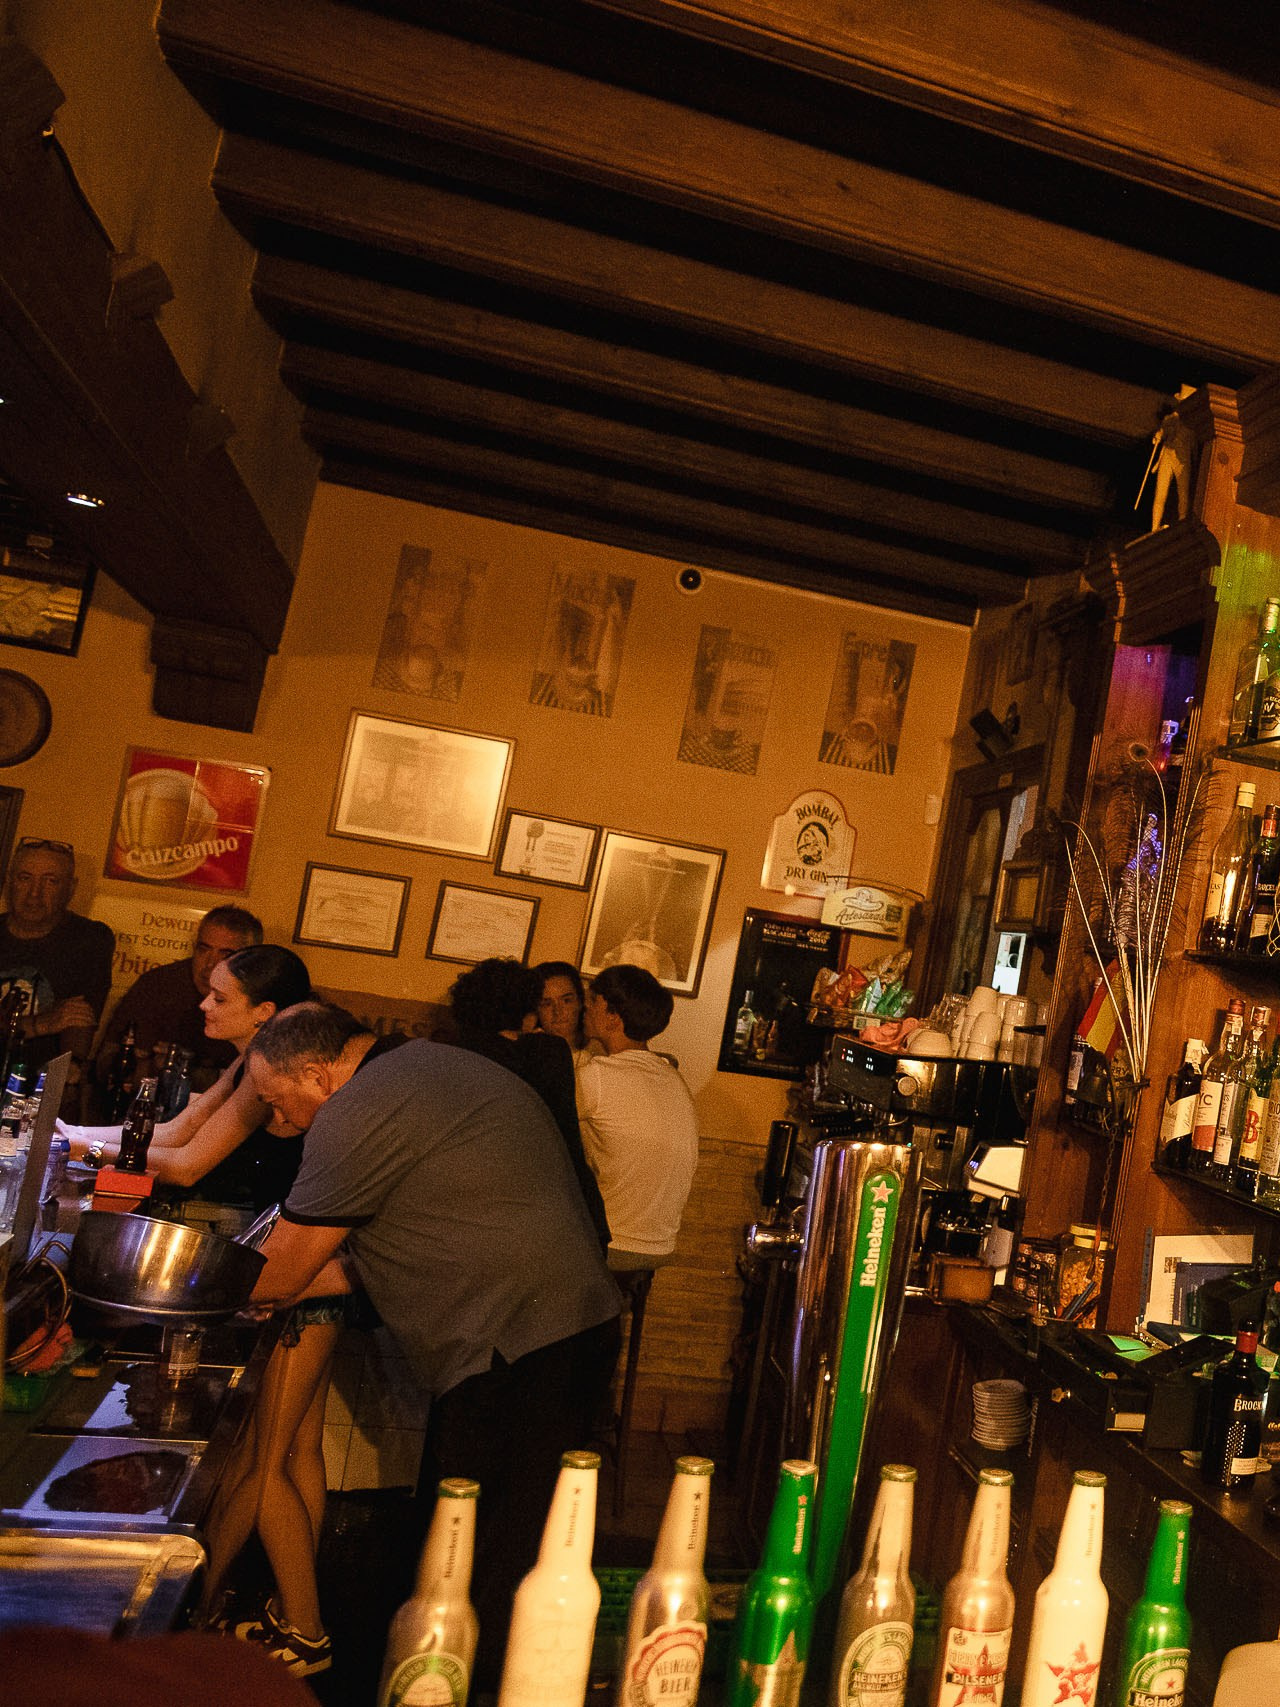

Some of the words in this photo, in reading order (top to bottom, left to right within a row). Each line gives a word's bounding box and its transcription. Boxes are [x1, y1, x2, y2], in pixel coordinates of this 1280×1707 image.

[795, 804, 841, 829] BOMBAY
[126, 837, 238, 868] Cruzcampo
[784, 866, 806, 880] DRY
[810, 869, 828, 885] GIN
[859, 1207, 888, 1288] Heineken
[687, 1505, 700, 1550] Heineken
[660, 1677, 690, 1694] BIER
[953, 1673, 1003, 1685] PILSENER
